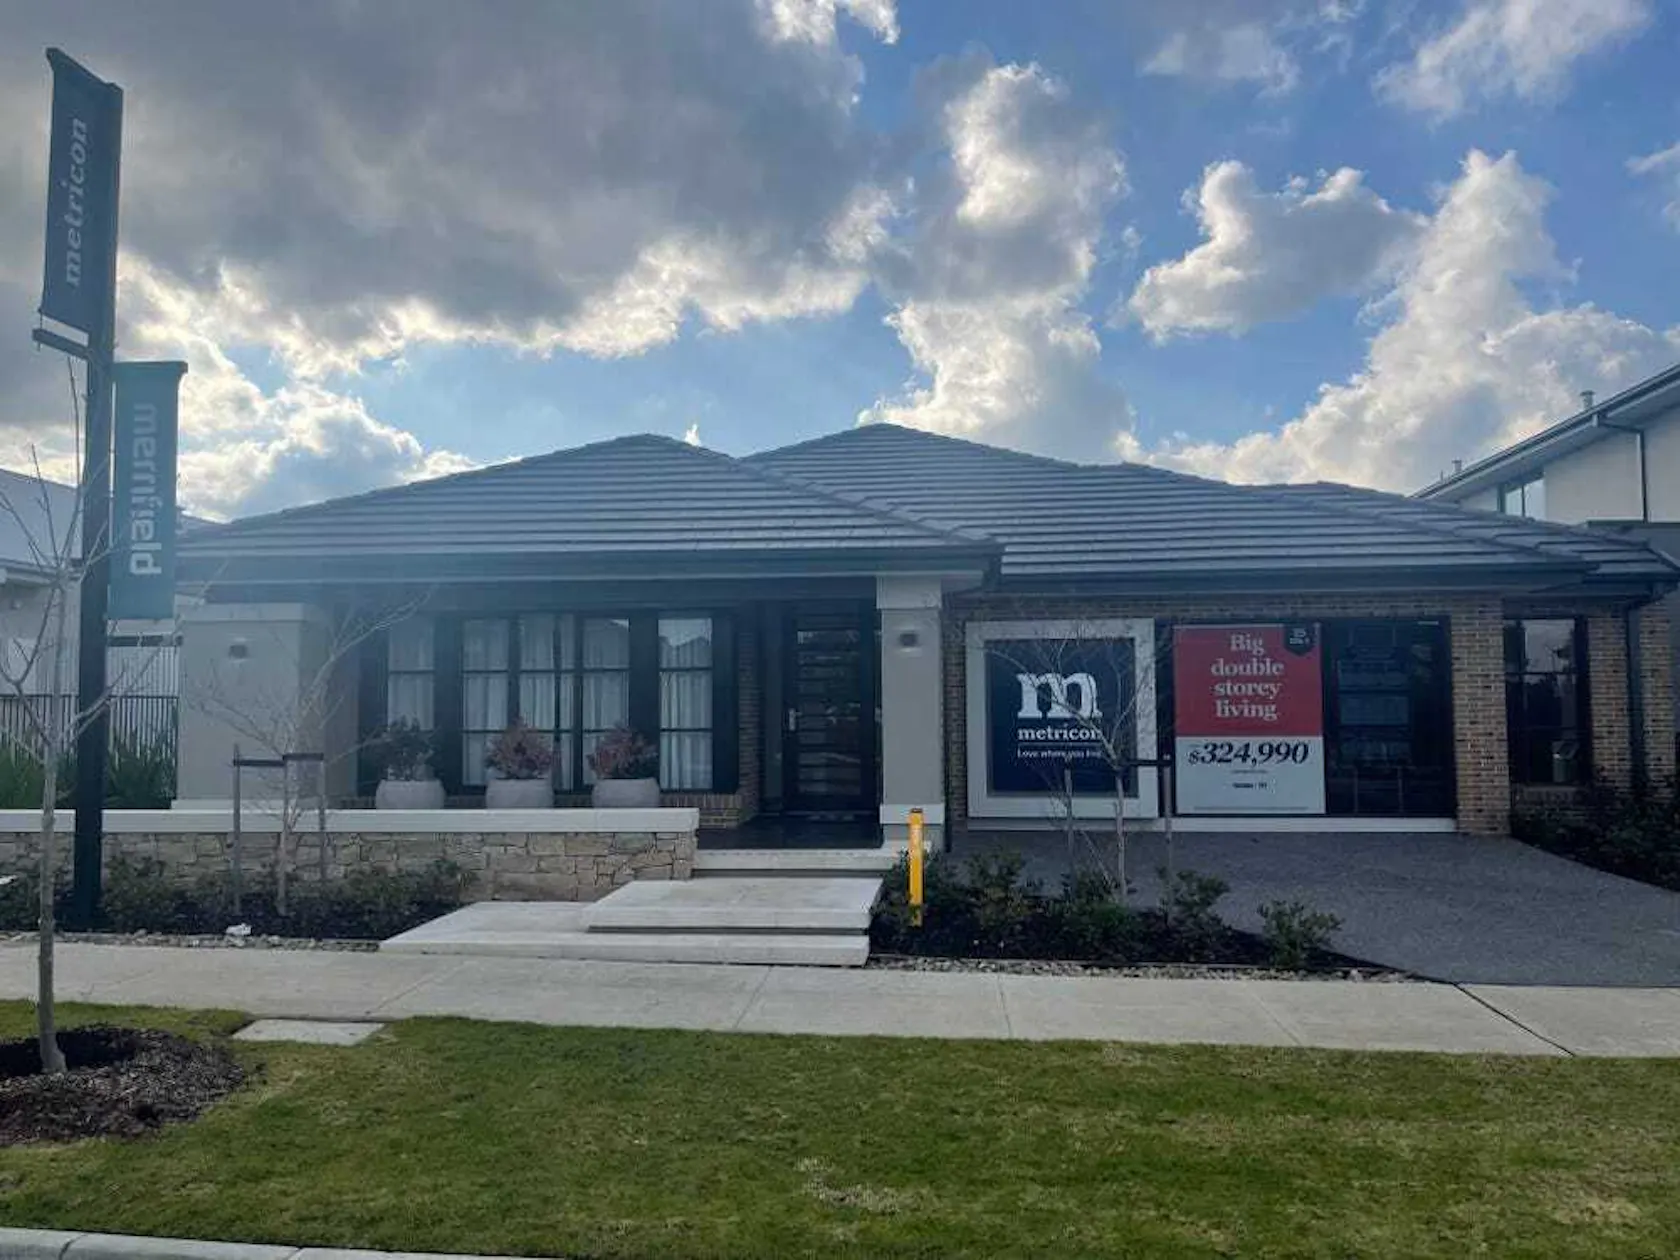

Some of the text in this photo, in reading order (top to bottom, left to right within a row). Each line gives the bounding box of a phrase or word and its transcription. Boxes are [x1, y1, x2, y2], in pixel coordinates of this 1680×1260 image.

[65, 118, 87, 287] metricon
[130, 403, 162, 574] merrifield
[1230, 633, 1265, 656] Big
[1210, 657, 1285, 676] double
[1016, 672, 1103, 719] m
[1213, 680, 1283, 700] storey
[1216, 699, 1278, 721] living
[1187, 741, 1310, 767] $324,990
